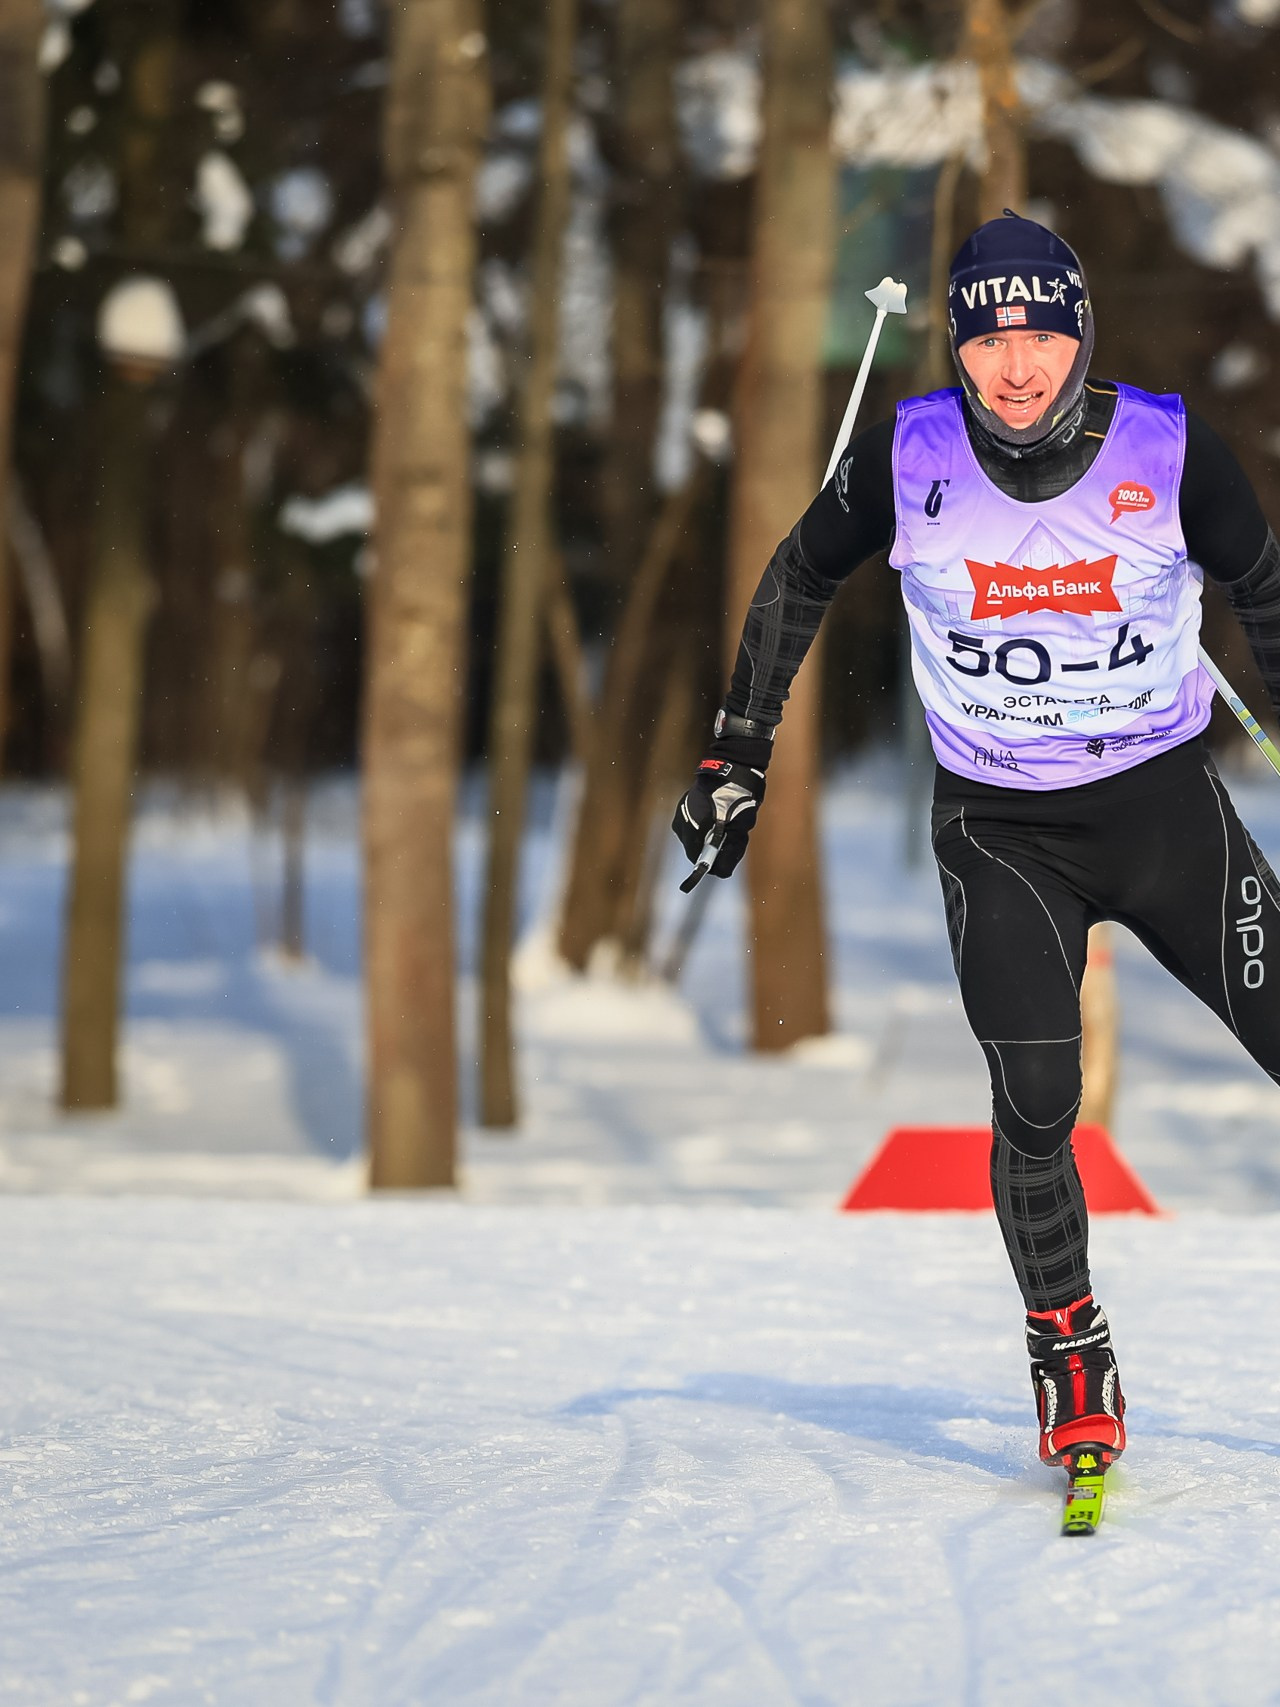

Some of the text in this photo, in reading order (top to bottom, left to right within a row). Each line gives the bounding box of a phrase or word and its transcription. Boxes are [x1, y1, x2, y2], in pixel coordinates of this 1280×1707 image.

[961, 276, 1050, 309] VITAL
[986, 579, 1103, 601] Альфа Банк
[1052, 1329, 1109, 1351] MADSHU
